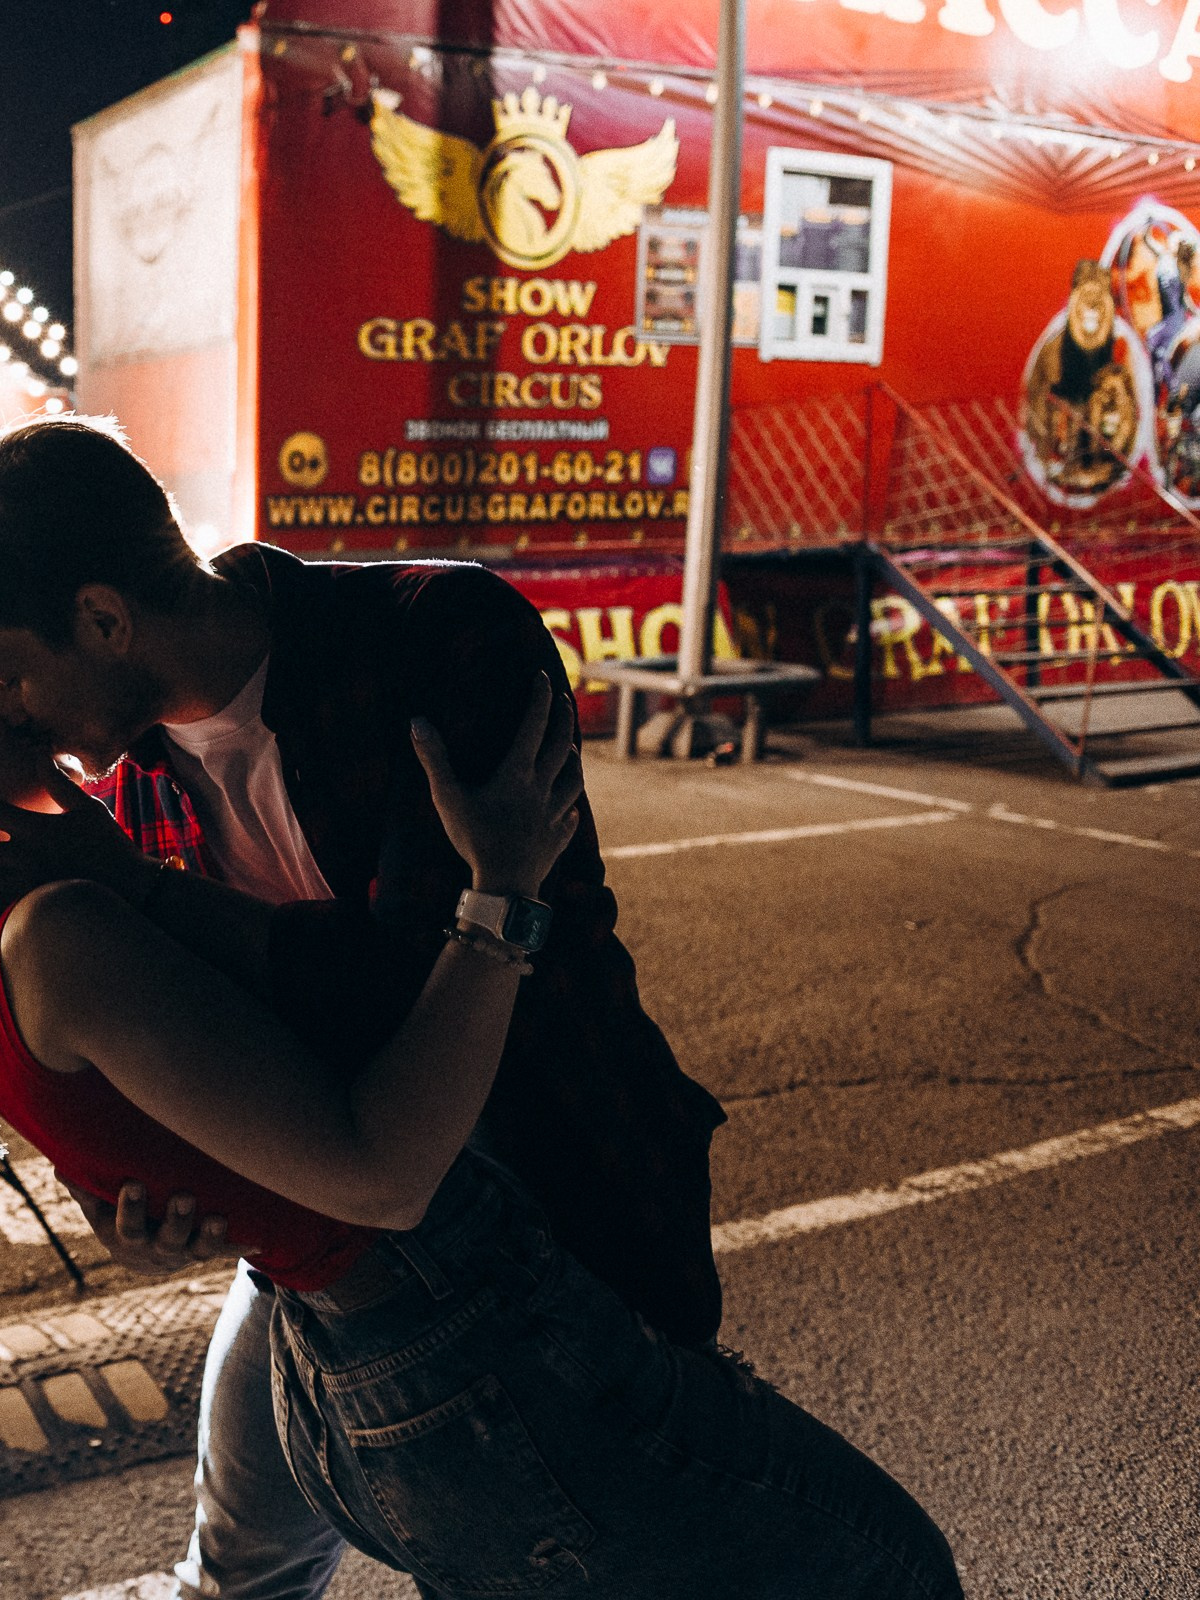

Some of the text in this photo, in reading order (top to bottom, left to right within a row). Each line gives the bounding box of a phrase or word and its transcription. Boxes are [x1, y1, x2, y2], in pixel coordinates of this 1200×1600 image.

[463, 276, 598, 318] SHOW
[357, 316, 508, 362] GRAF
[448, 371, 604, 410] CIRCUS
[358, 447, 643, 489] 8(800)201-60-21
